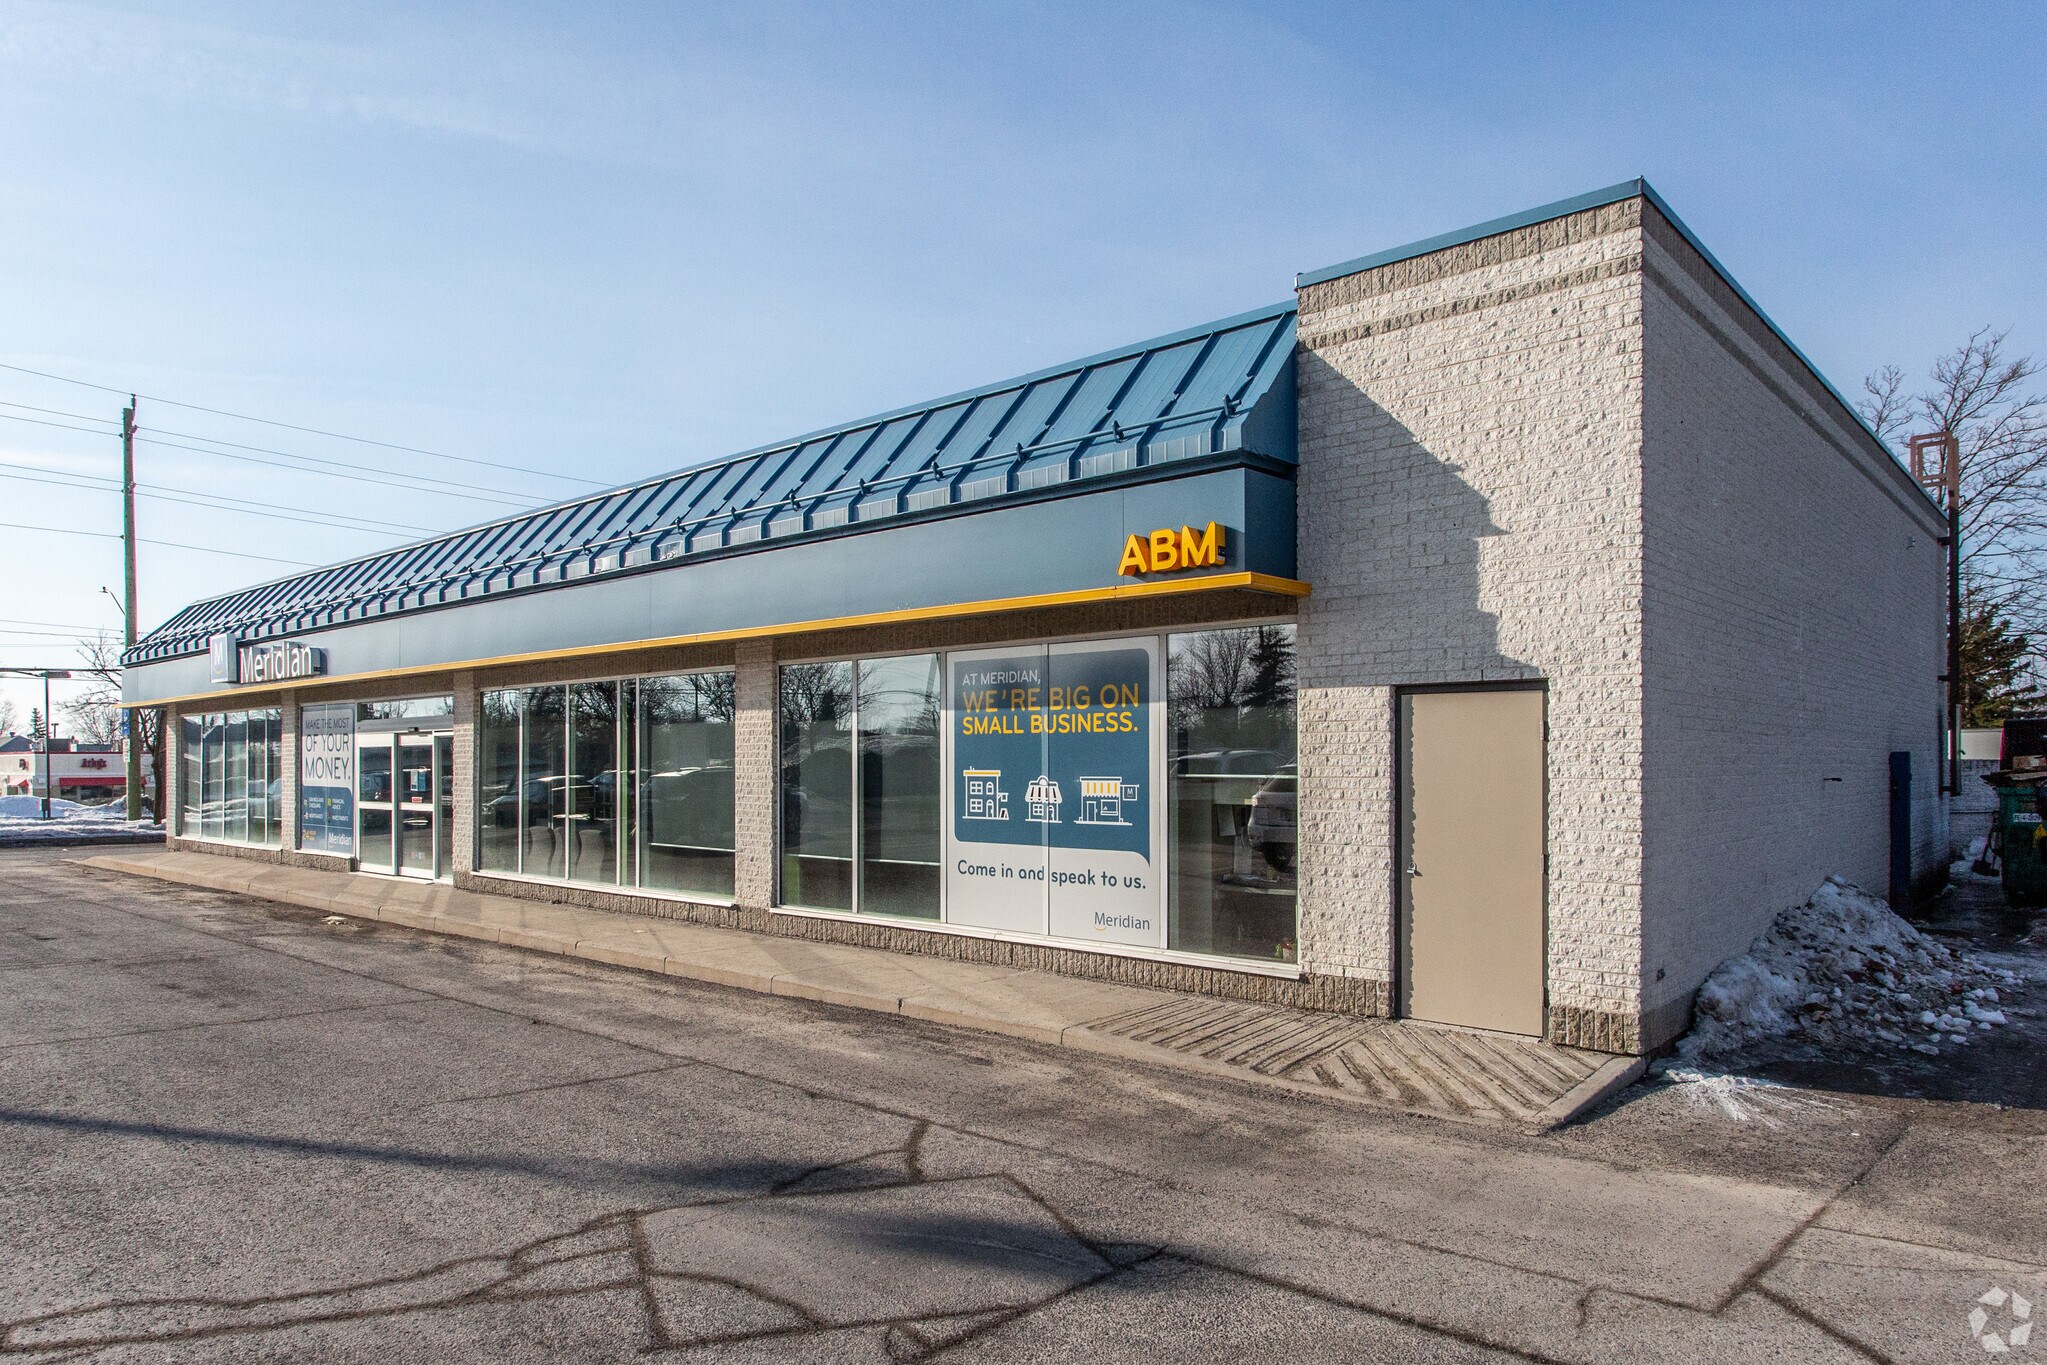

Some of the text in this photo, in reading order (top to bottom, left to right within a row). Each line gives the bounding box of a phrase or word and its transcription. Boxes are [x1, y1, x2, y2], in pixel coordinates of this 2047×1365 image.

[1117, 521, 1217, 576] ABM
[240, 641, 312, 684] Meridian
[962, 669, 1041, 686] AT MERIDIAN,
[962, 682, 1139, 714] WE'RE BIG ON
[306, 717, 350, 729] MAKE THE MOST
[962, 711, 1139, 735] SMALL BUSINESS.
[306, 733, 349, 752] OF YOUR
[306, 757, 350, 780] MONEY.
[328, 832, 352, 846] Meridian
[957, 859, 1147, 890] Come in and speak to us.
[1094, 912, 1150, 931] Meridian
